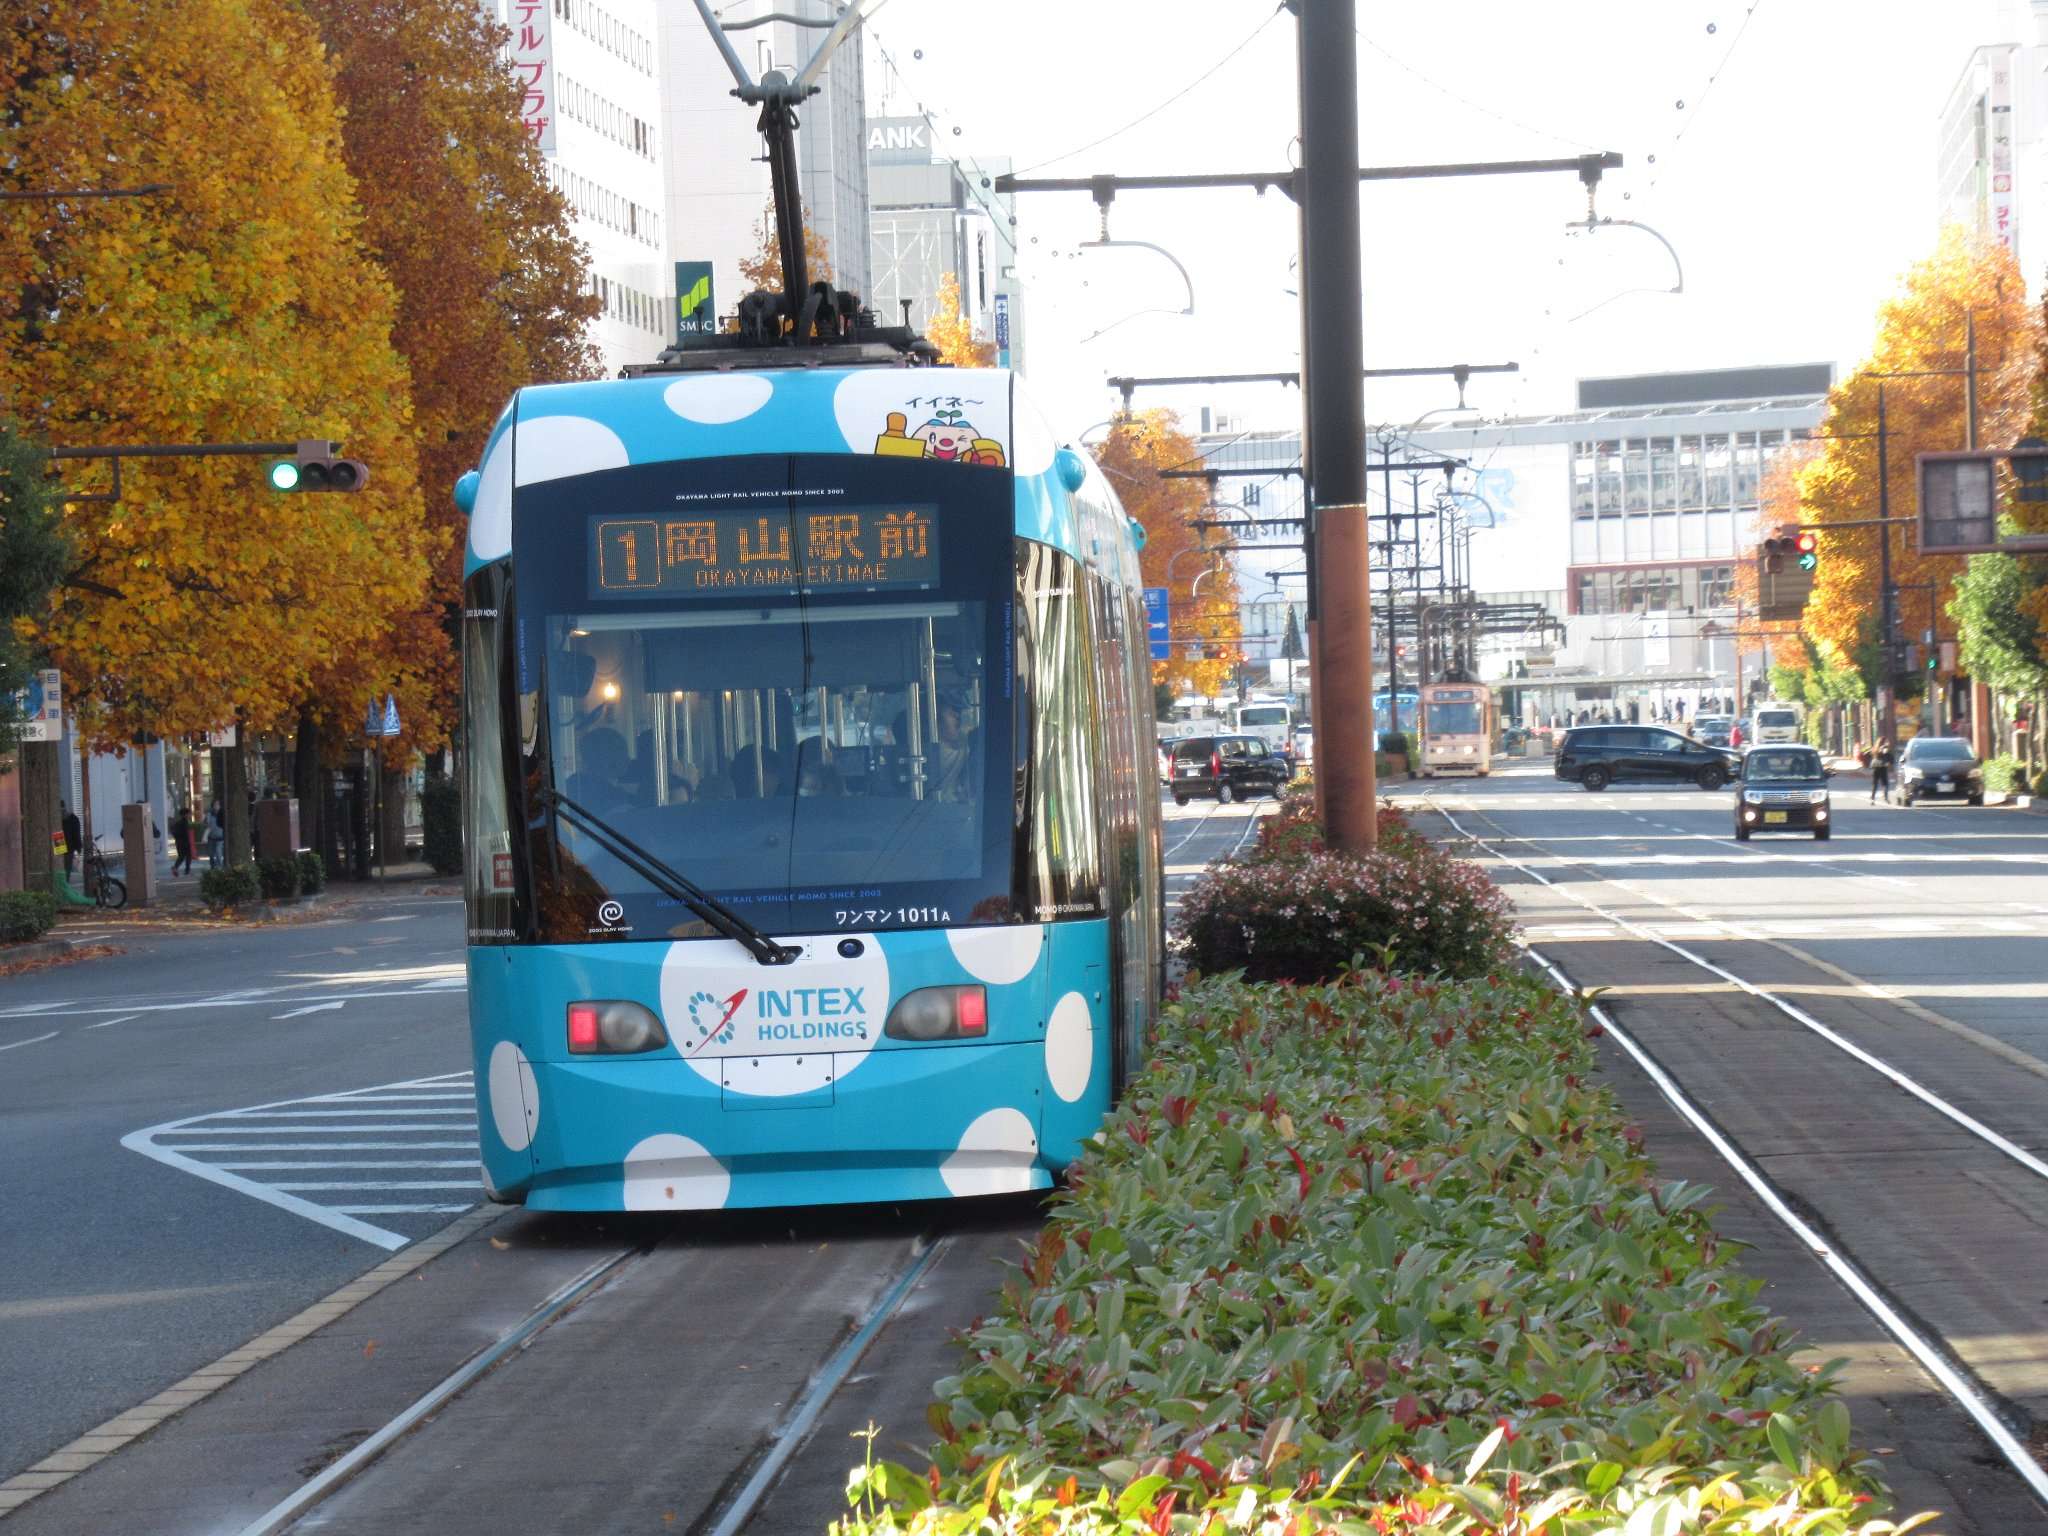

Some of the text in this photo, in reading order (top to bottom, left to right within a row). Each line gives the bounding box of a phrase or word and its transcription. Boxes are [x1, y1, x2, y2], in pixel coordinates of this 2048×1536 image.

[617, 511, 931, 580] 1 岡山駅前
[836, 907, 951, 925] ワンマン 1011A
[758, 987, 866, 1018] INTEX
[758, 1021, 867, 1040] HOLDINGS
